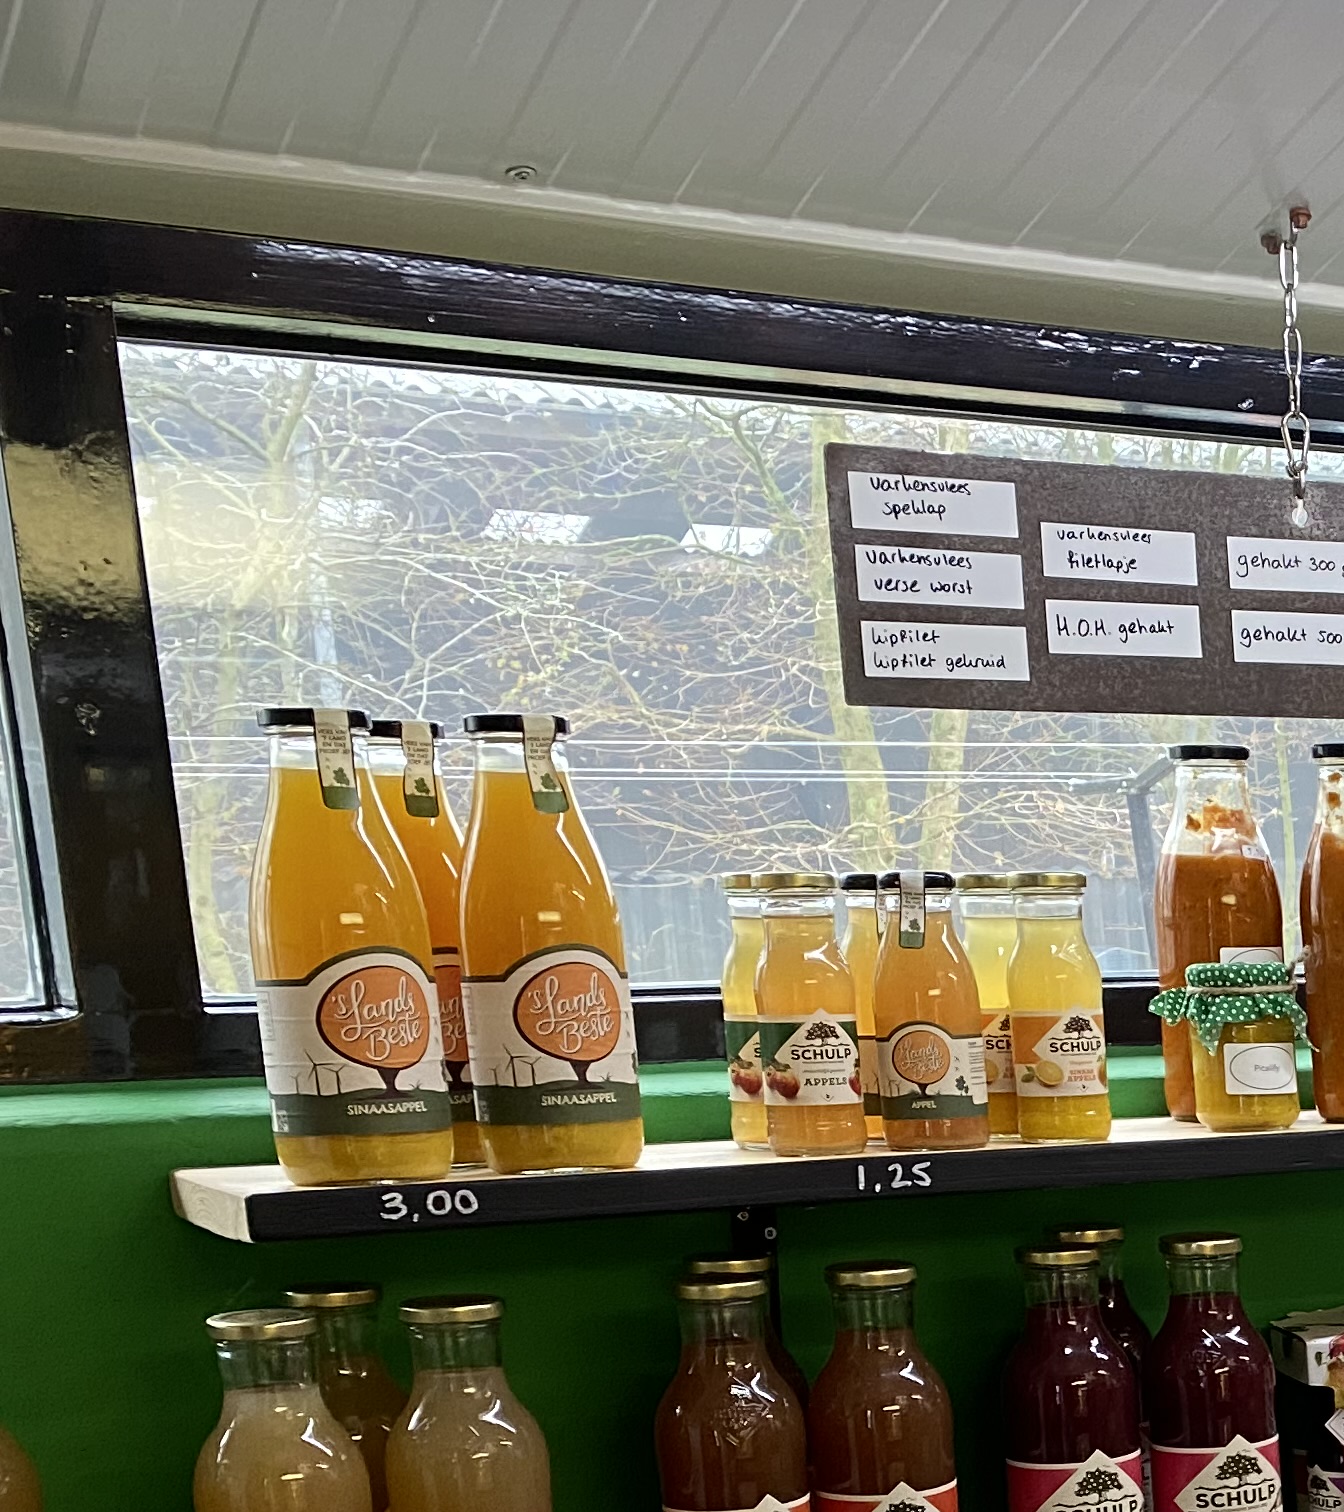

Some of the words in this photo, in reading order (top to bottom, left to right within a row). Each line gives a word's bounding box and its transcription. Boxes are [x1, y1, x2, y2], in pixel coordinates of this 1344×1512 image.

[882, 498, 947, 520] speklap
[1066, 552, 1139, 573] filetlapje
[1235, 552, 1302, 578] gehakt
[1308, 557, 1336, 572] 300
[873, 577, 922, 593] verse
[930, 576, 974, 594] worst
[871, 625, 941, 646] kipfilet
[1118, 618, 1176, 643] gehakt
[1239, 624, 1308, 647] gehakt
[1316, 629, 1343, 646] 500
[872, 651, 938, 672] kipfilet
[945, 651, 1007, 672] gekruid
[365, 1018, 423, 1063] Beste
[561, 1011, 615, 1054] Beste
[790, 1047, 852, 1061] SCHULP
[1049, 1039, 1102, 1052] SCHULP
[803, 1076, 848, 1087] APPELS
[346, 1101, 428, 1116] SINAASAPPEL
[541, 1092, 617, 1107] SINAASAPPEL
[911, 1100, 937, 1109] APPEL
[1195, 1483, 1275, 1510] SCHULP
